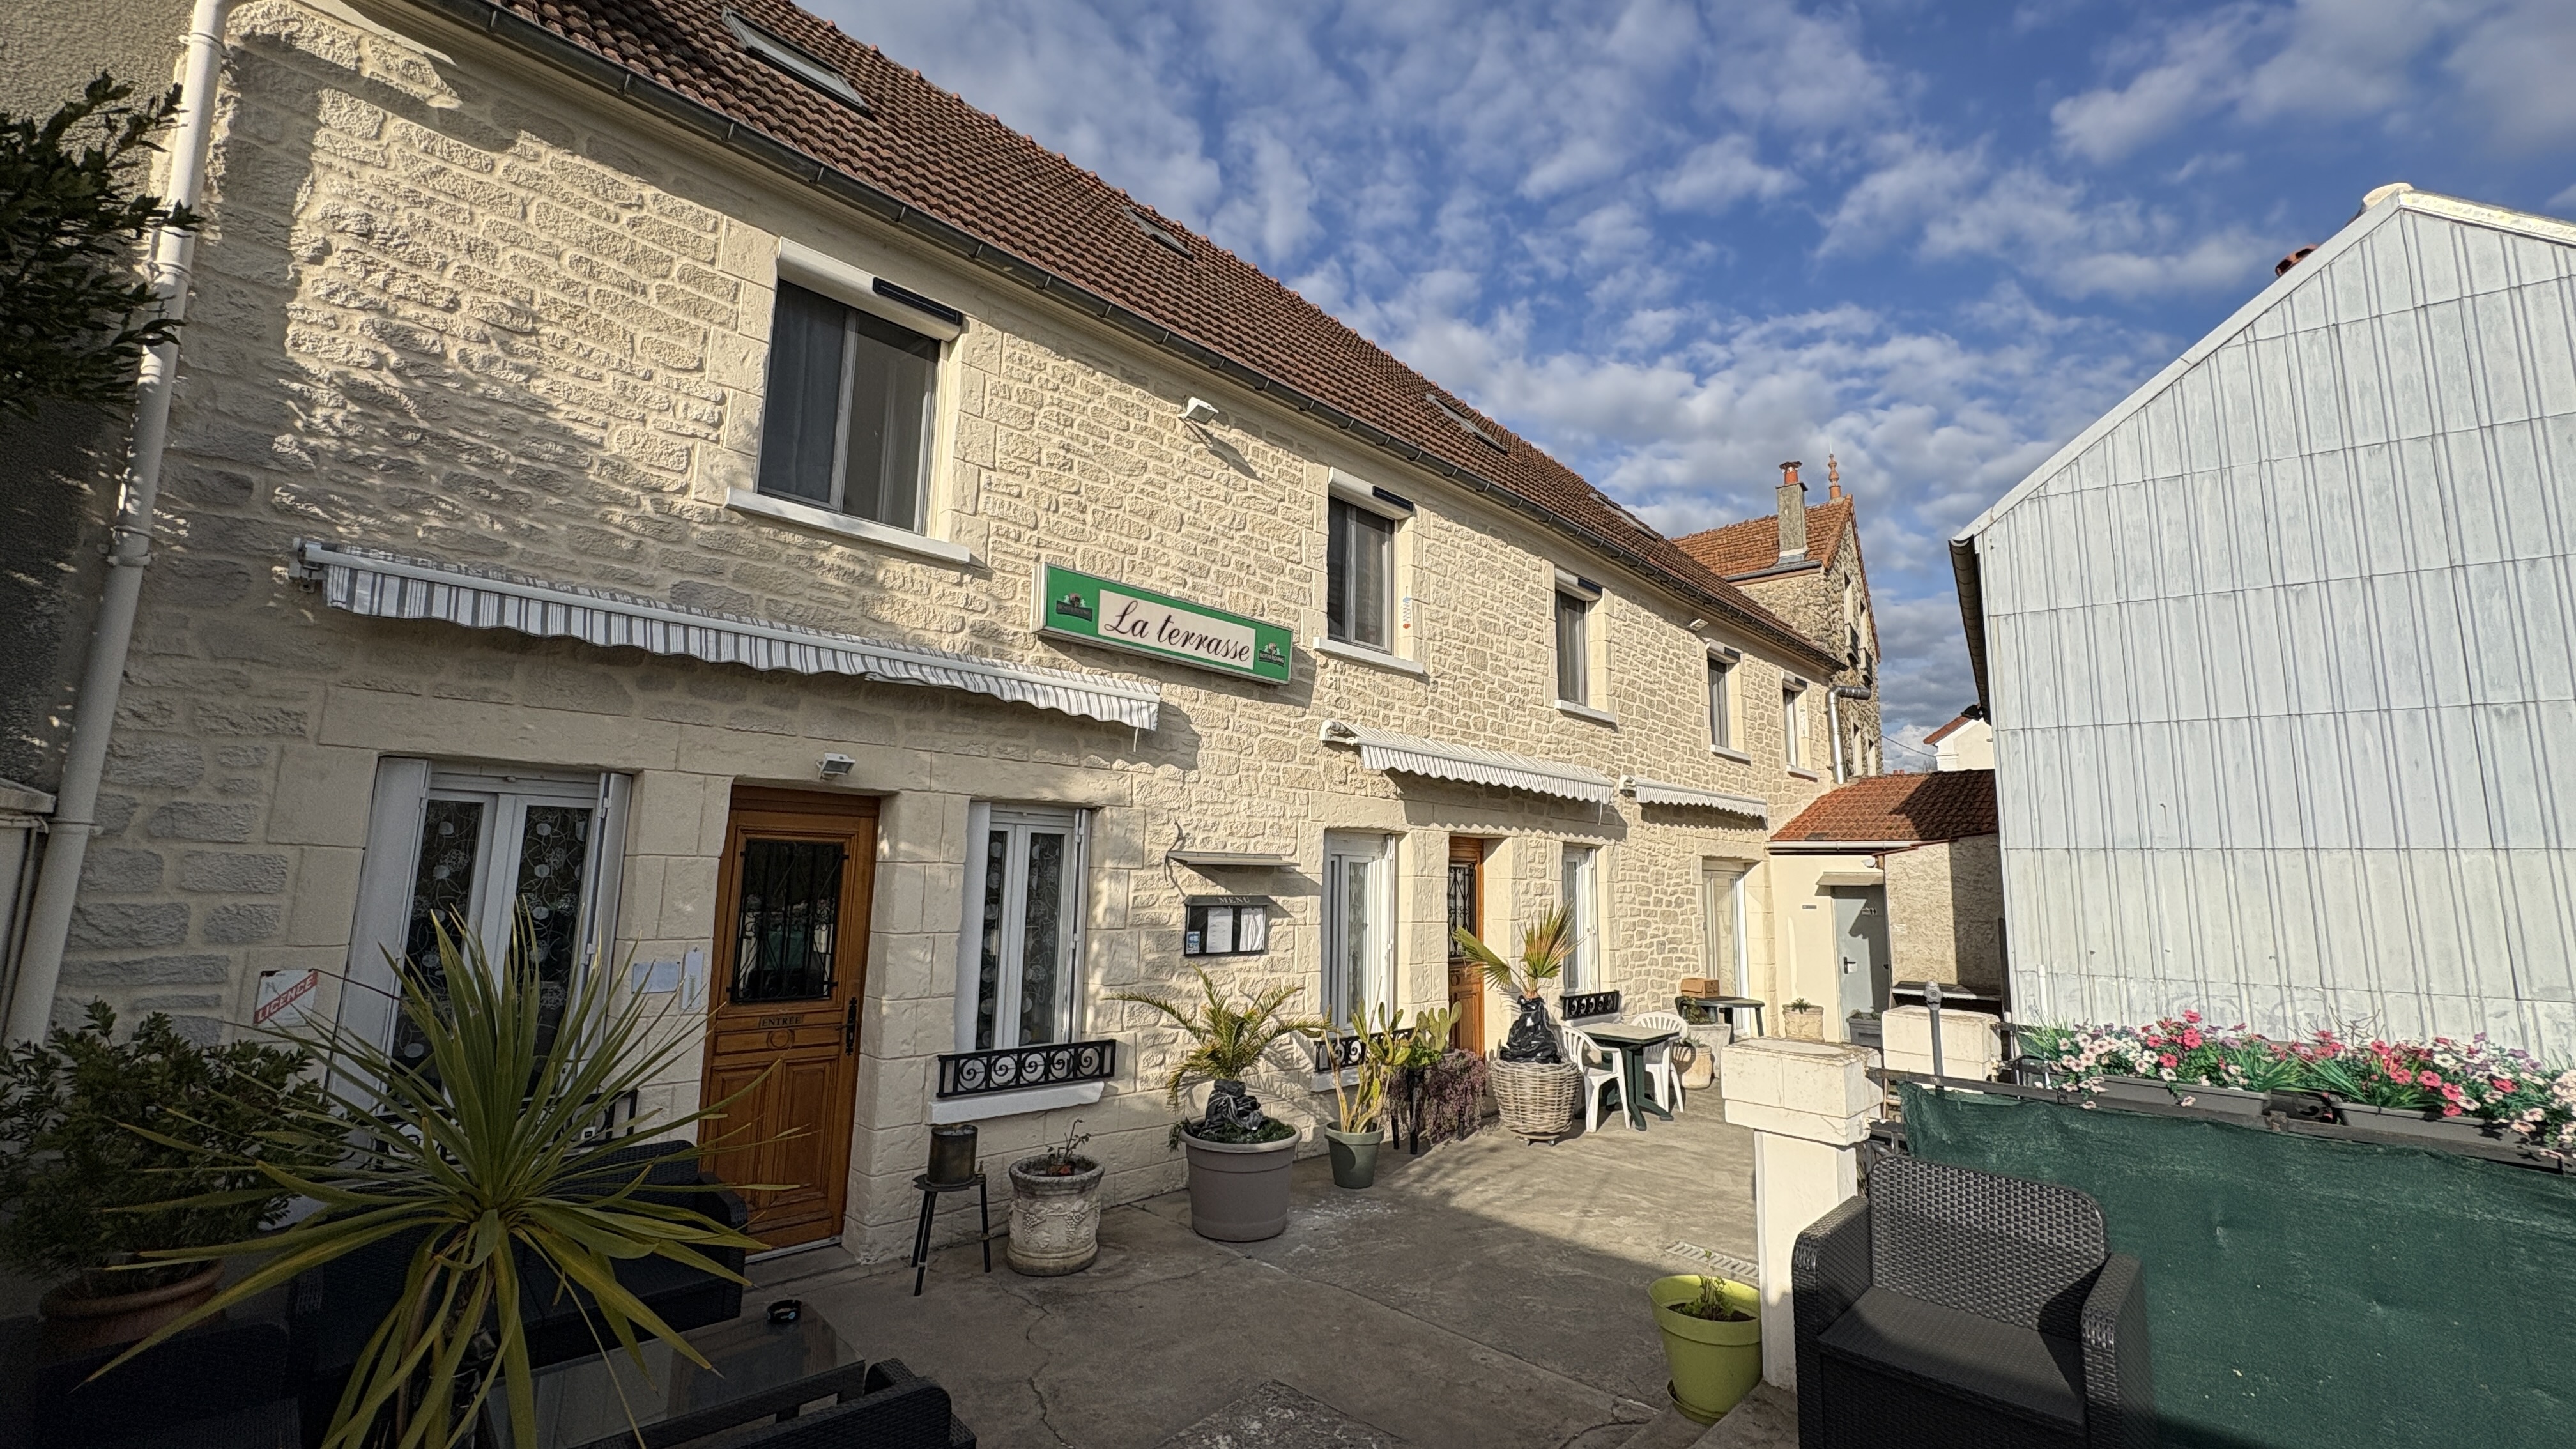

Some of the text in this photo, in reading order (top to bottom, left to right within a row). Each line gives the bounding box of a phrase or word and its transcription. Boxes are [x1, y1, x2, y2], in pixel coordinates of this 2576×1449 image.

[1104, 600, 1250, 662] La terrasse
[257, 975, 314, 1022] LICENCE
